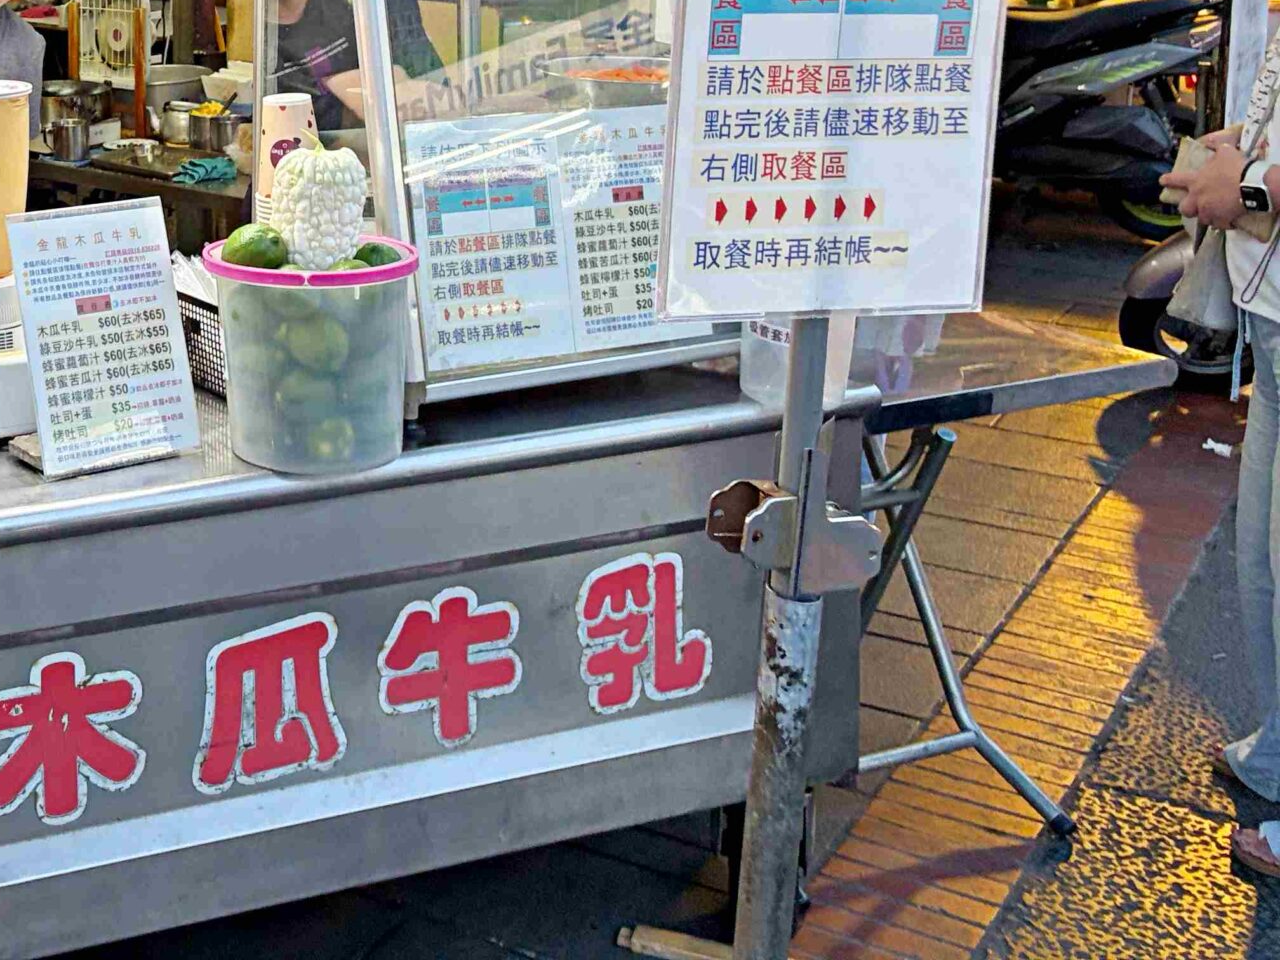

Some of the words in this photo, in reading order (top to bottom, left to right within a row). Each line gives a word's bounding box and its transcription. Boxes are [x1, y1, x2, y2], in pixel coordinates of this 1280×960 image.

[707, 63, 971, 96] 請於點餐區排隊點餐
[703, 108, 969, 140] 點完後請儘速移動至
[701, 152, 848, 183] 右側取餐區
[575, 209, 614, 222] 木瓜牛乳
[629, 204, 659, 216] $60(去
[37, 227, 142, 252] 金龍木瓜牛乳
[576, 221, 627, 237] 綠豆沙牛乳
[429, 232, 556, 256] 請於點餐區排隊點餐
[577, 236, 628, 254] 蜂蜜蘿蔔汁
[431, 254, 558, 278] 點完後請儘速移動至
[578, 251, 629, 269] 蜂蜜苦瓜汁
[580, 265, 630, 285] 蜂蜜檸檬汁
[634, 267, 651, 278] $50
[434, 278, 504, 299] 右側取餐區
[581, 284, 618, 300] 吐司+蛋
[635, 284, 651, 294] $35
[583, 302, 614, 317] 烤吐司
[636, 298, 653, 310] $20
[38, 320, 83, 338] 木瓜牛乳
[98, 308, 166, 328] $60(去冰$65)
[40, 335, 98, 356] 綠豆沙牛乳
[101, 325, 169, 345] $50(去冰$55)
[42, 352, 100, 373] 蜂蜜蘿蔔汁
[104, 342, 172, 362] $60(去冰$65)
[45, 369, 102, 390] 蜂蜜苦瓜汁
[107, 359, 175, 378] $60(去冰$65)
[47, 388, 105, 408] 蜂蜜檸檬汁
[110, 383, 129, 397] $50
[50, 407, 93, 425] 吐司+蛋
[112, 401, 131, 414] $35
[53, 426, 89, 443] 烤吐司
[114, 418, 133, 432] $20
